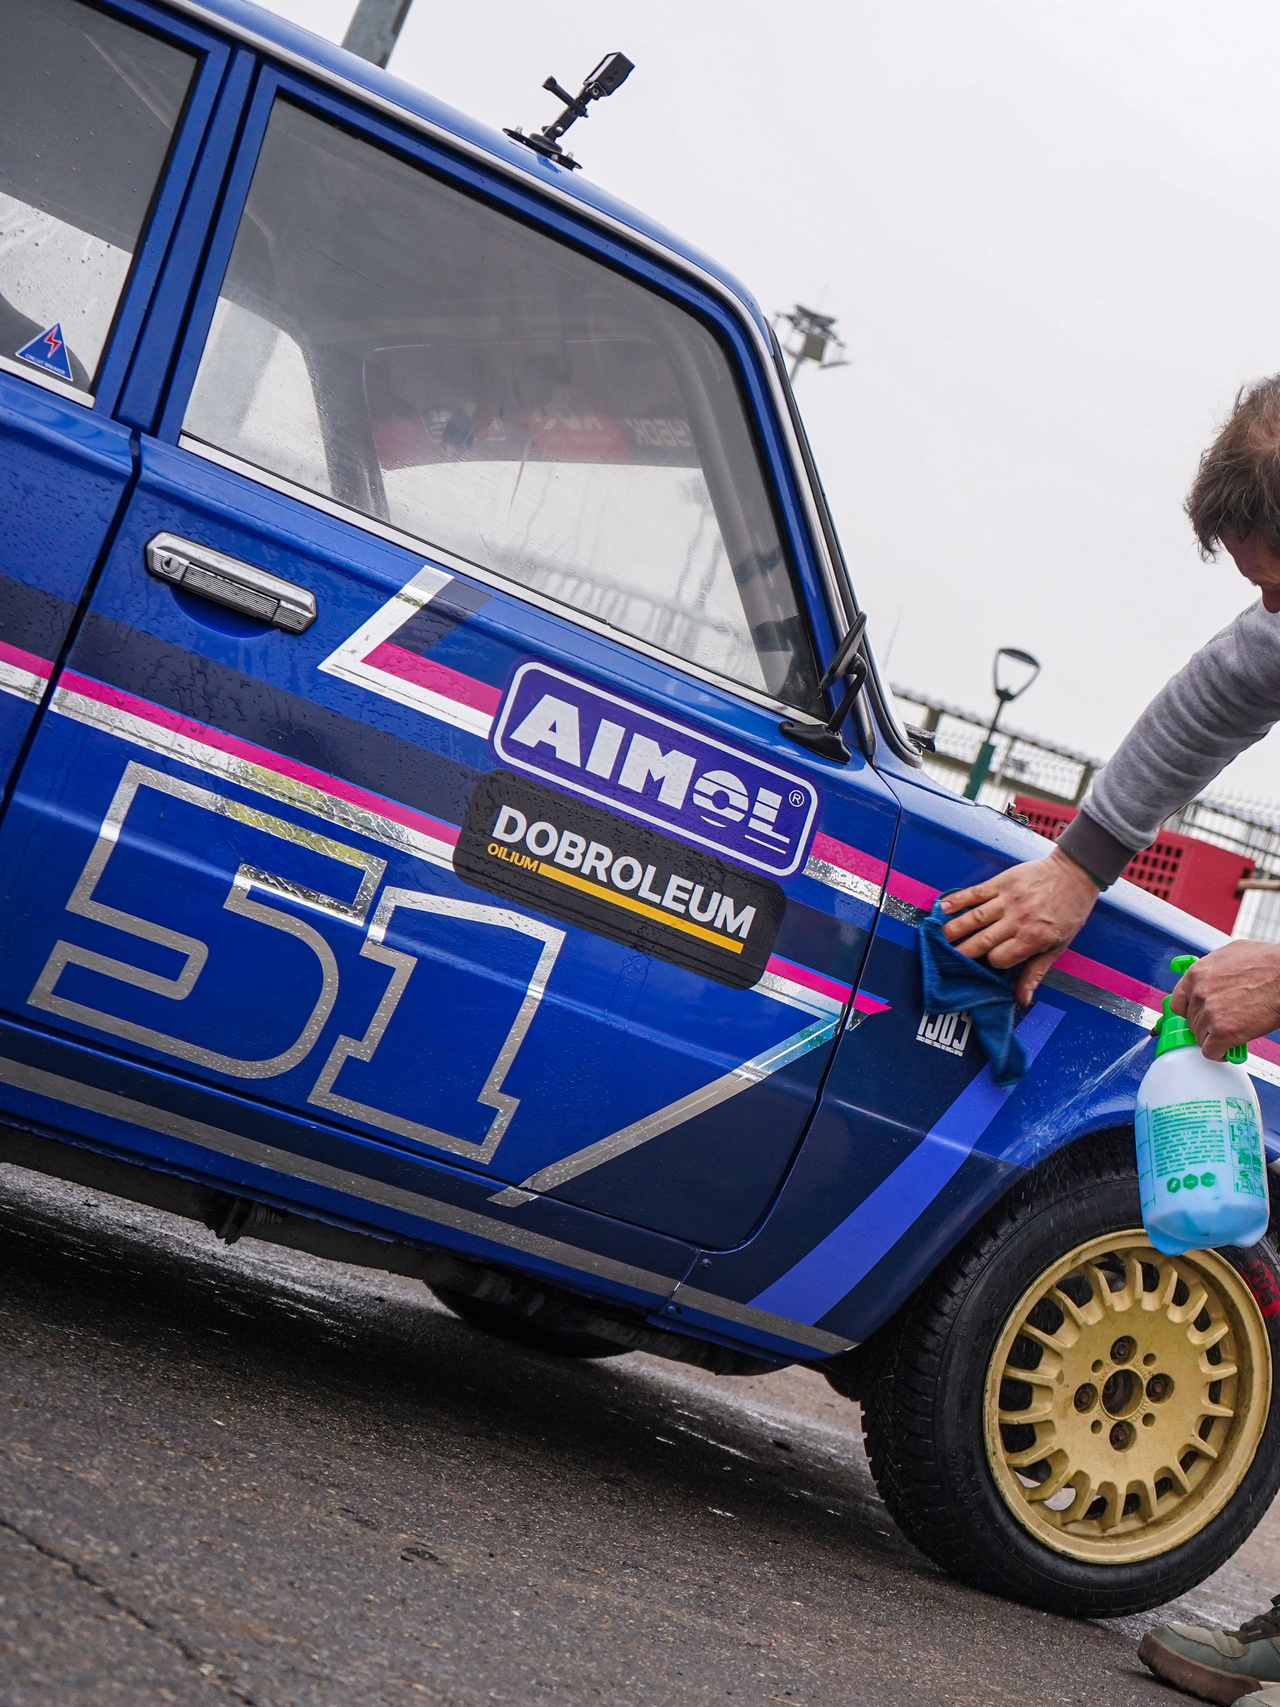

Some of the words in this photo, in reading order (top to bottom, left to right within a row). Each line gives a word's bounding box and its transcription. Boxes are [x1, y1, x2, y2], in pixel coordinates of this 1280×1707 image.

[487, 842, 540, 873] OILIUM
[491, 804, 757, 939] DOBROLEUM
[26, 759, 567, 1165] 51
